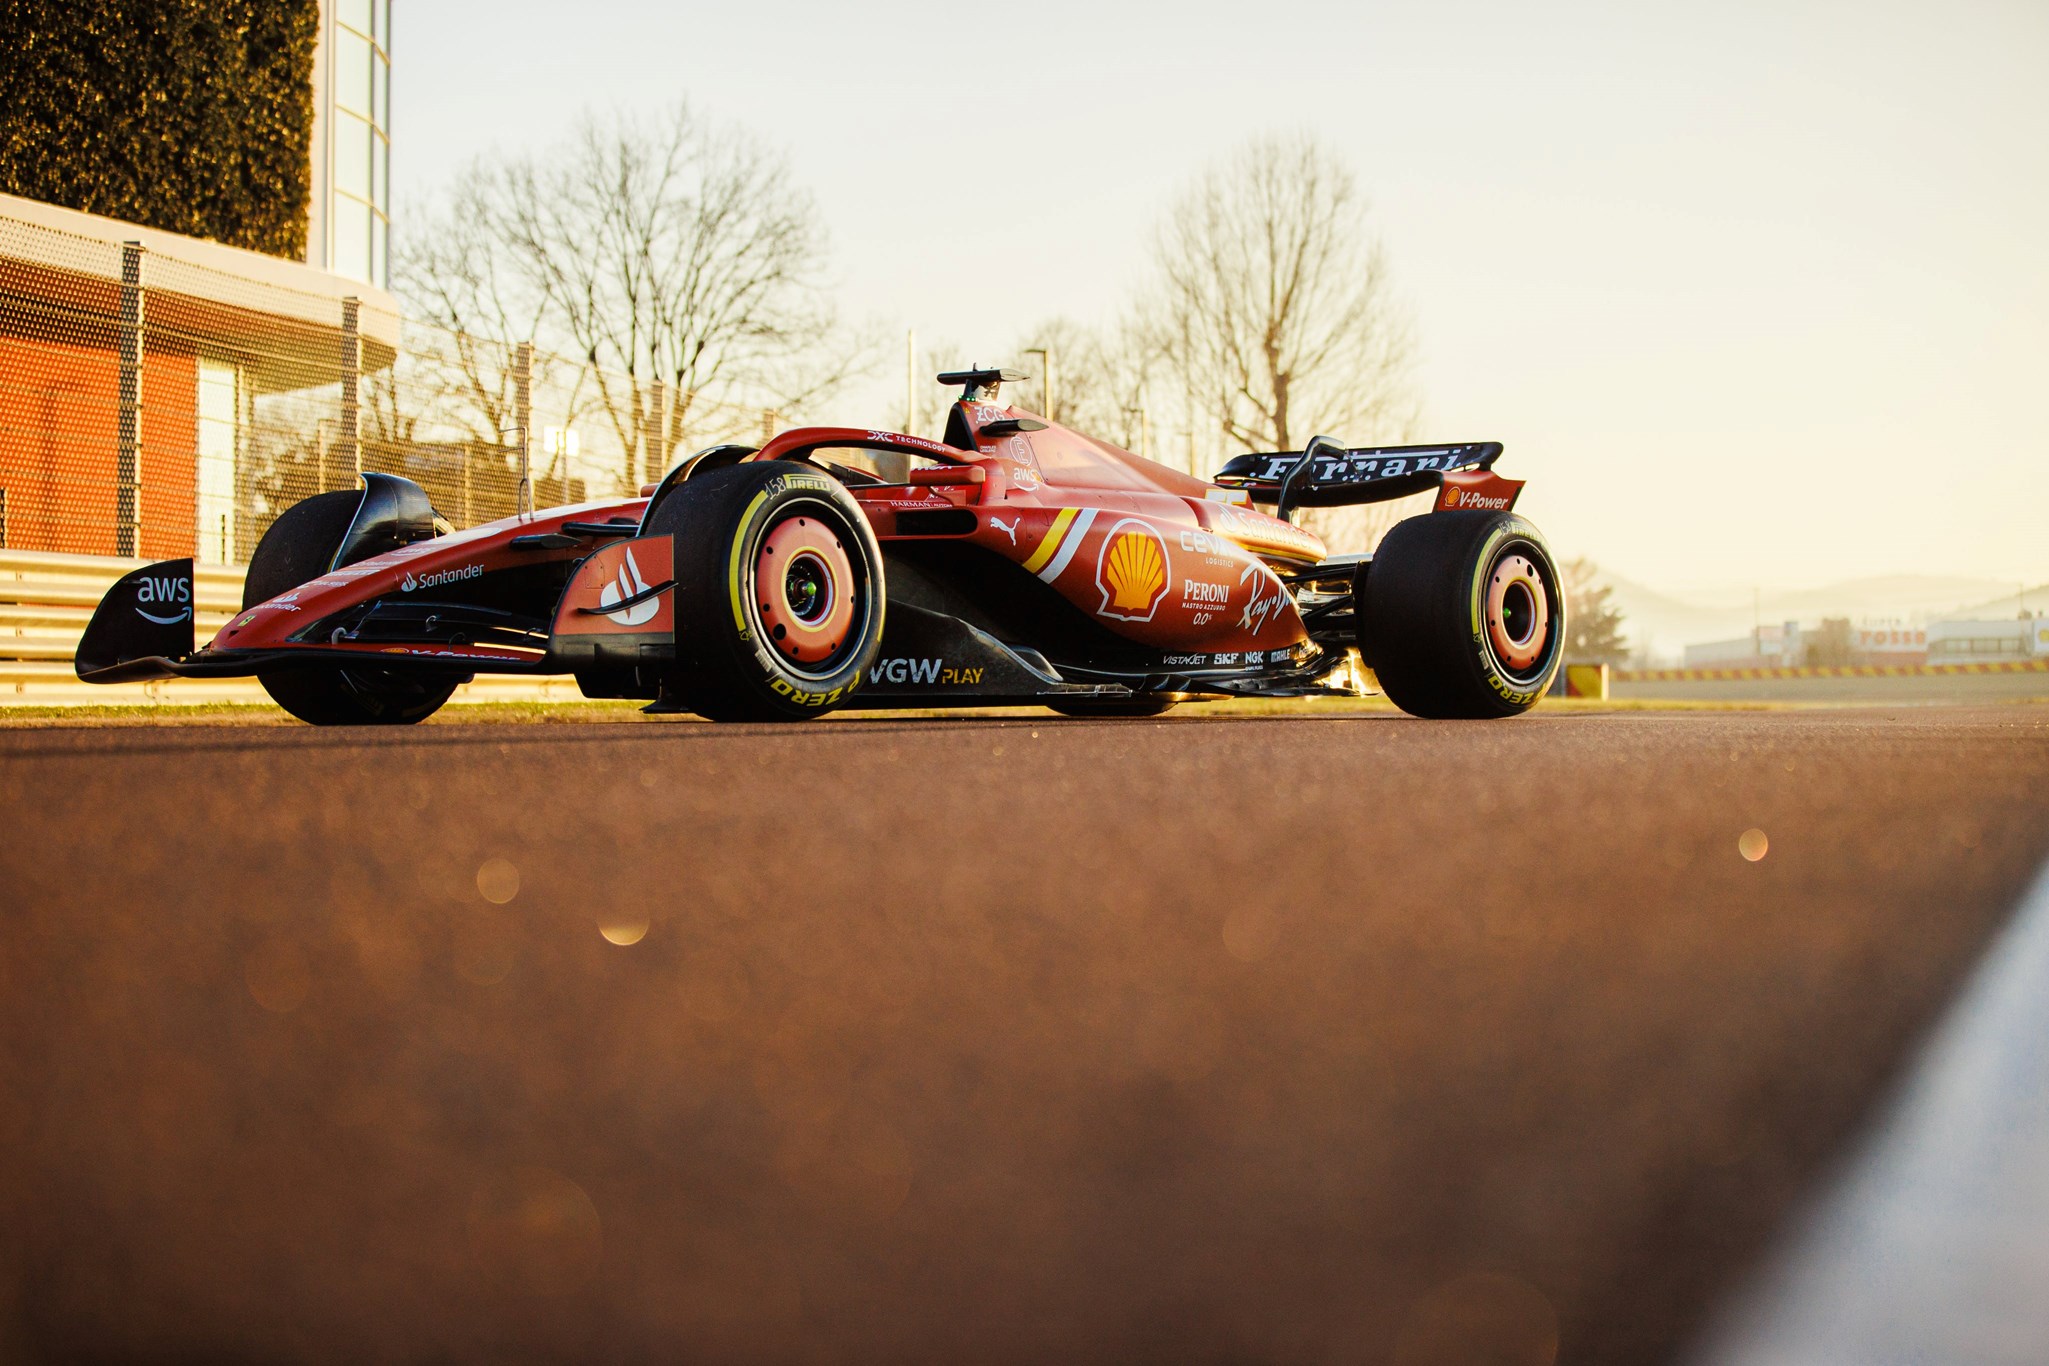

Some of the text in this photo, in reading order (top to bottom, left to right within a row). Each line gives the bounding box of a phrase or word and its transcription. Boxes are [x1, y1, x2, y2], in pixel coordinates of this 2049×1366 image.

[896, 435, 946, 452] TECHNOLOGY
[1258, 448, 1461, 480] Frrari
[783, 473, 830, 492] PIRELLI
[1459, 491, 1508, 509] V-Power
[1239, 512, 1314, 550] Santander
[1205, 557, 1234, 568] LOGISTICS
[418, 563, 485, 589] Santander
[138, 576, 190, 602] aws
[1183, 579, 1229, 603] PERONI
[1181, 602, 1204, 610] NASTRO
[1213, 653, 1239, 665] SKF
[1245, 651, 1264, 664] NGK
[870, 658, 984, 684] VGW PLAY
[771, 679, 842, 707] ZERO
[1488, 675, 1534, 704] ZERO
